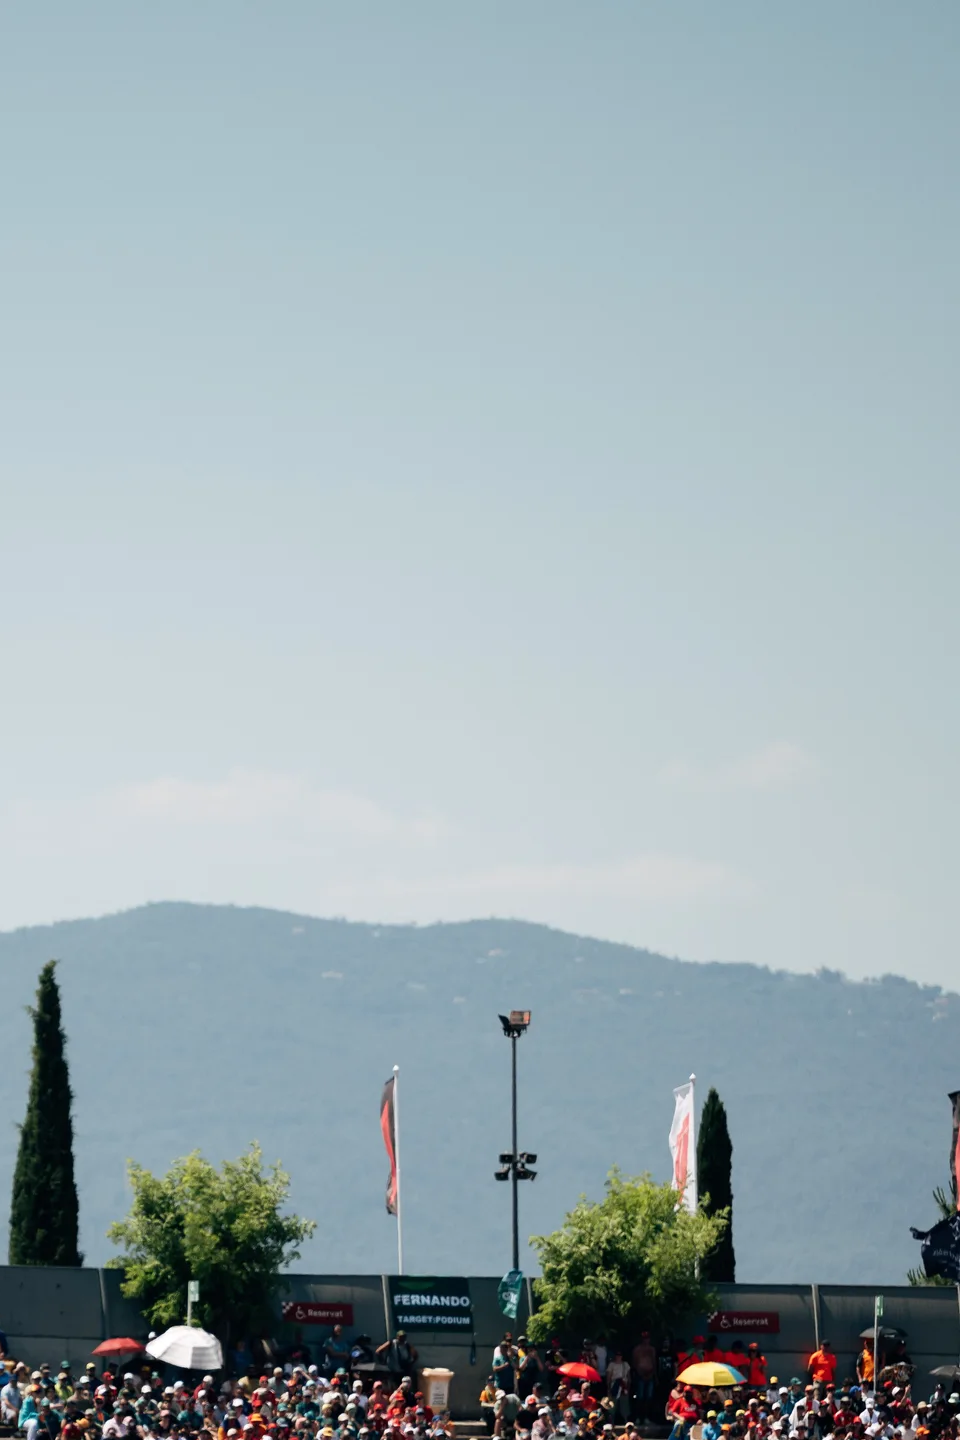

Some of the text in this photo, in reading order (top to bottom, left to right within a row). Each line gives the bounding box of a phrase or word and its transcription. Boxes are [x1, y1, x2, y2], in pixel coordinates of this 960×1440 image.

[393, 1294, 470, 1307] FERNANDO
[307, 1309, 343, 1317] Reservat
[733, 1317, 768, 1326] Reservat
